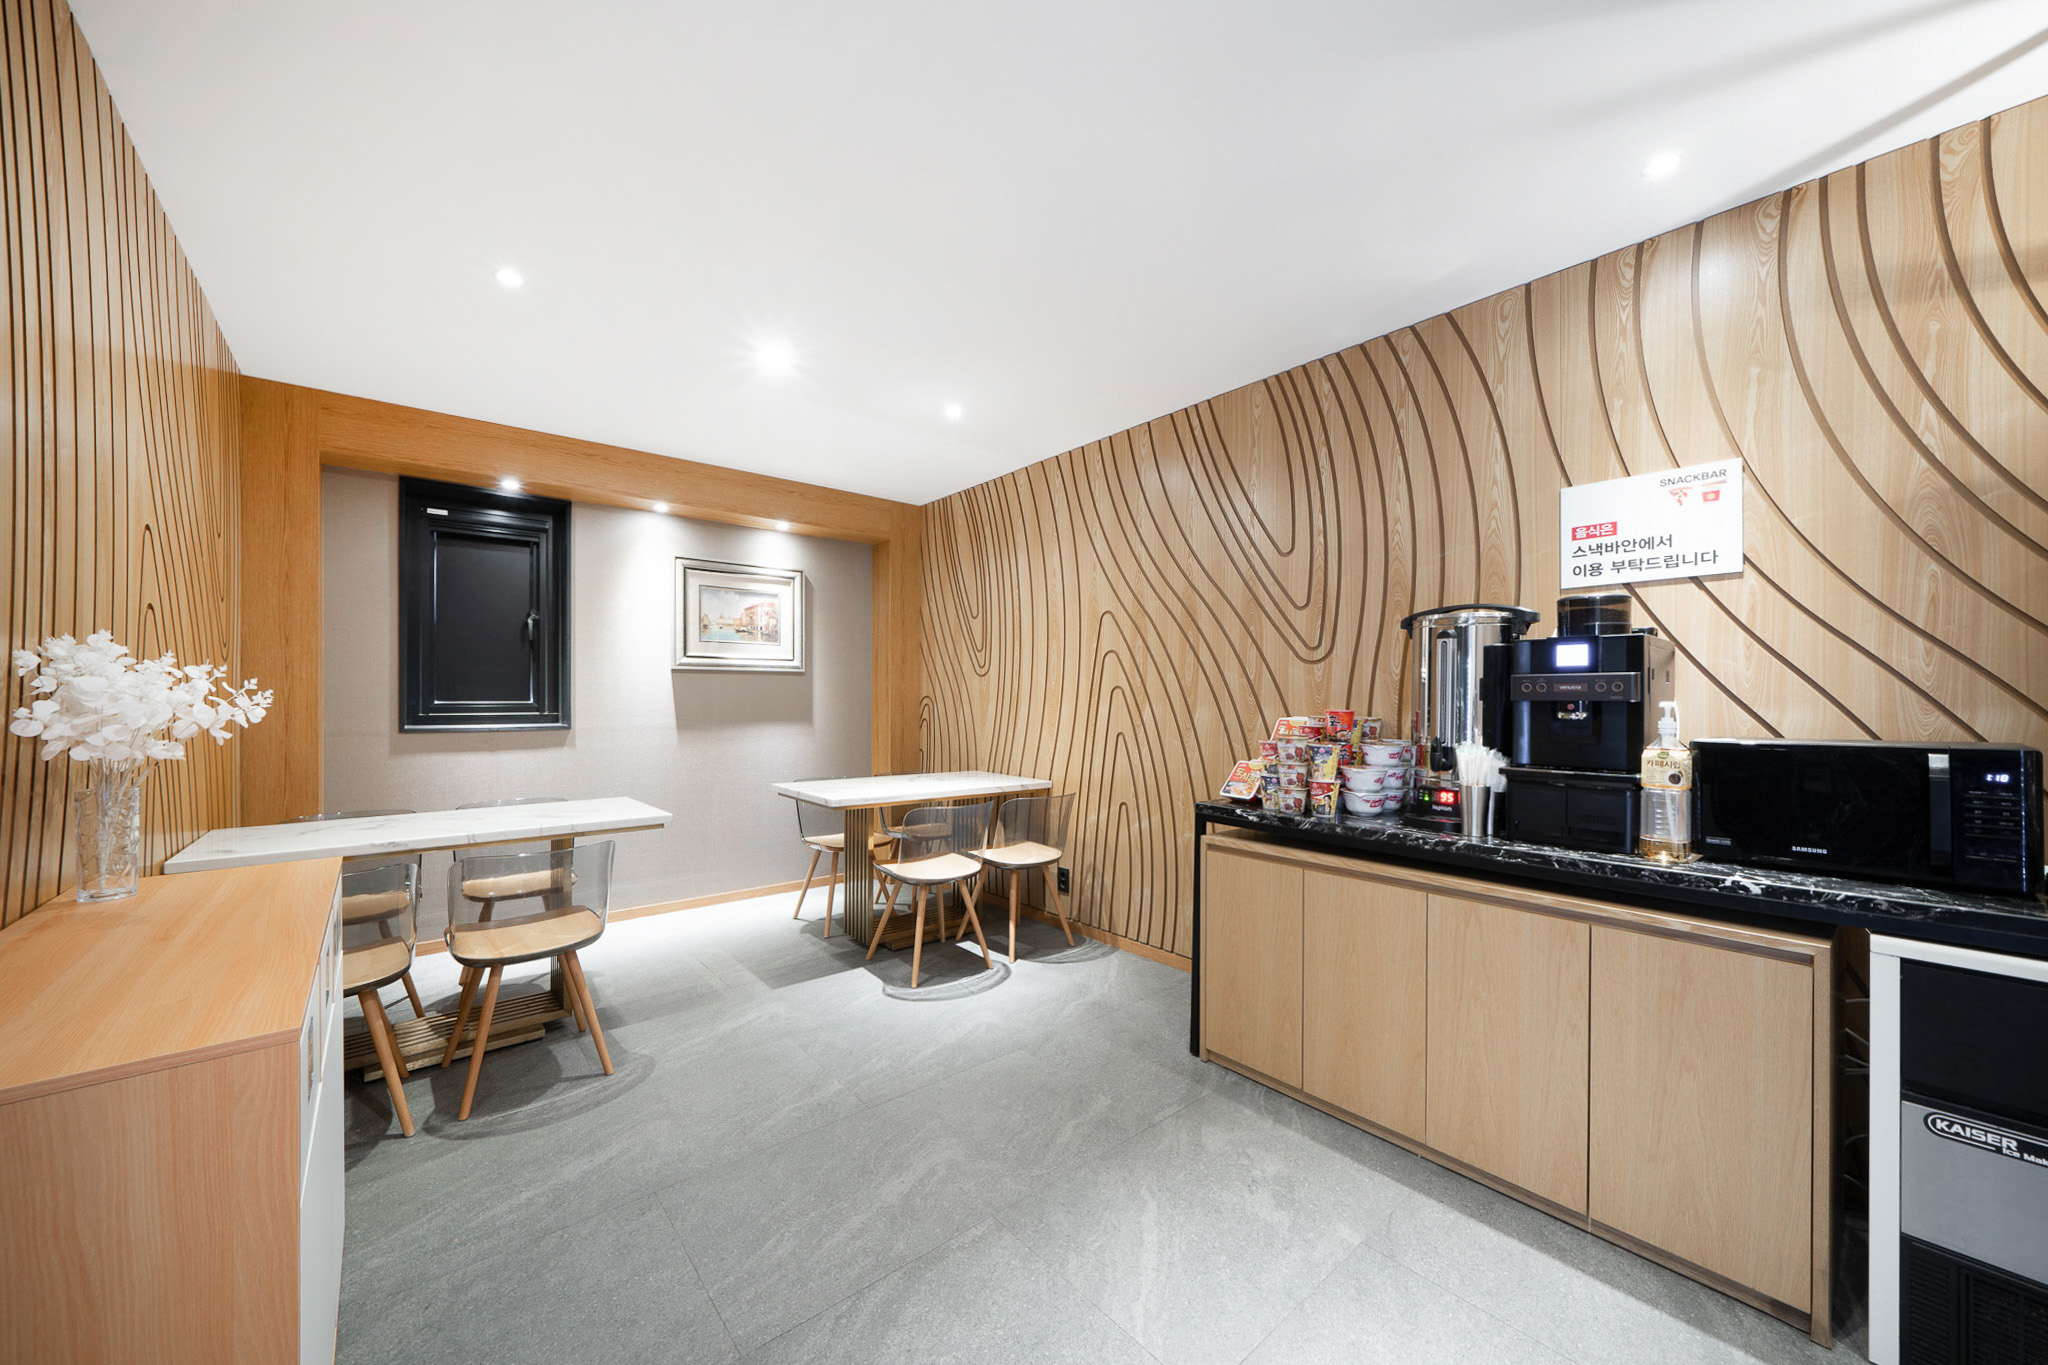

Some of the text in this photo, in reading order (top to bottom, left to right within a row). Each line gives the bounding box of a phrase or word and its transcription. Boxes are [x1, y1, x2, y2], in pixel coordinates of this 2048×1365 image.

[1660, 469, 1727, 487] SNACKBAR
[1574, 523, 1614, 539] 음식은
[1572, 534, 1673, 558] 스낵바안에서
[1572, 550, 1719, 577] 이용 부탁드립니다
[1440, 791, 1454, 803] 95
[1792, 845, 1828, 854] SAMSUNG
[1935, 1118, 2018, 1151] KAISER
[2002, 1147, 2020, 1158] Ice
